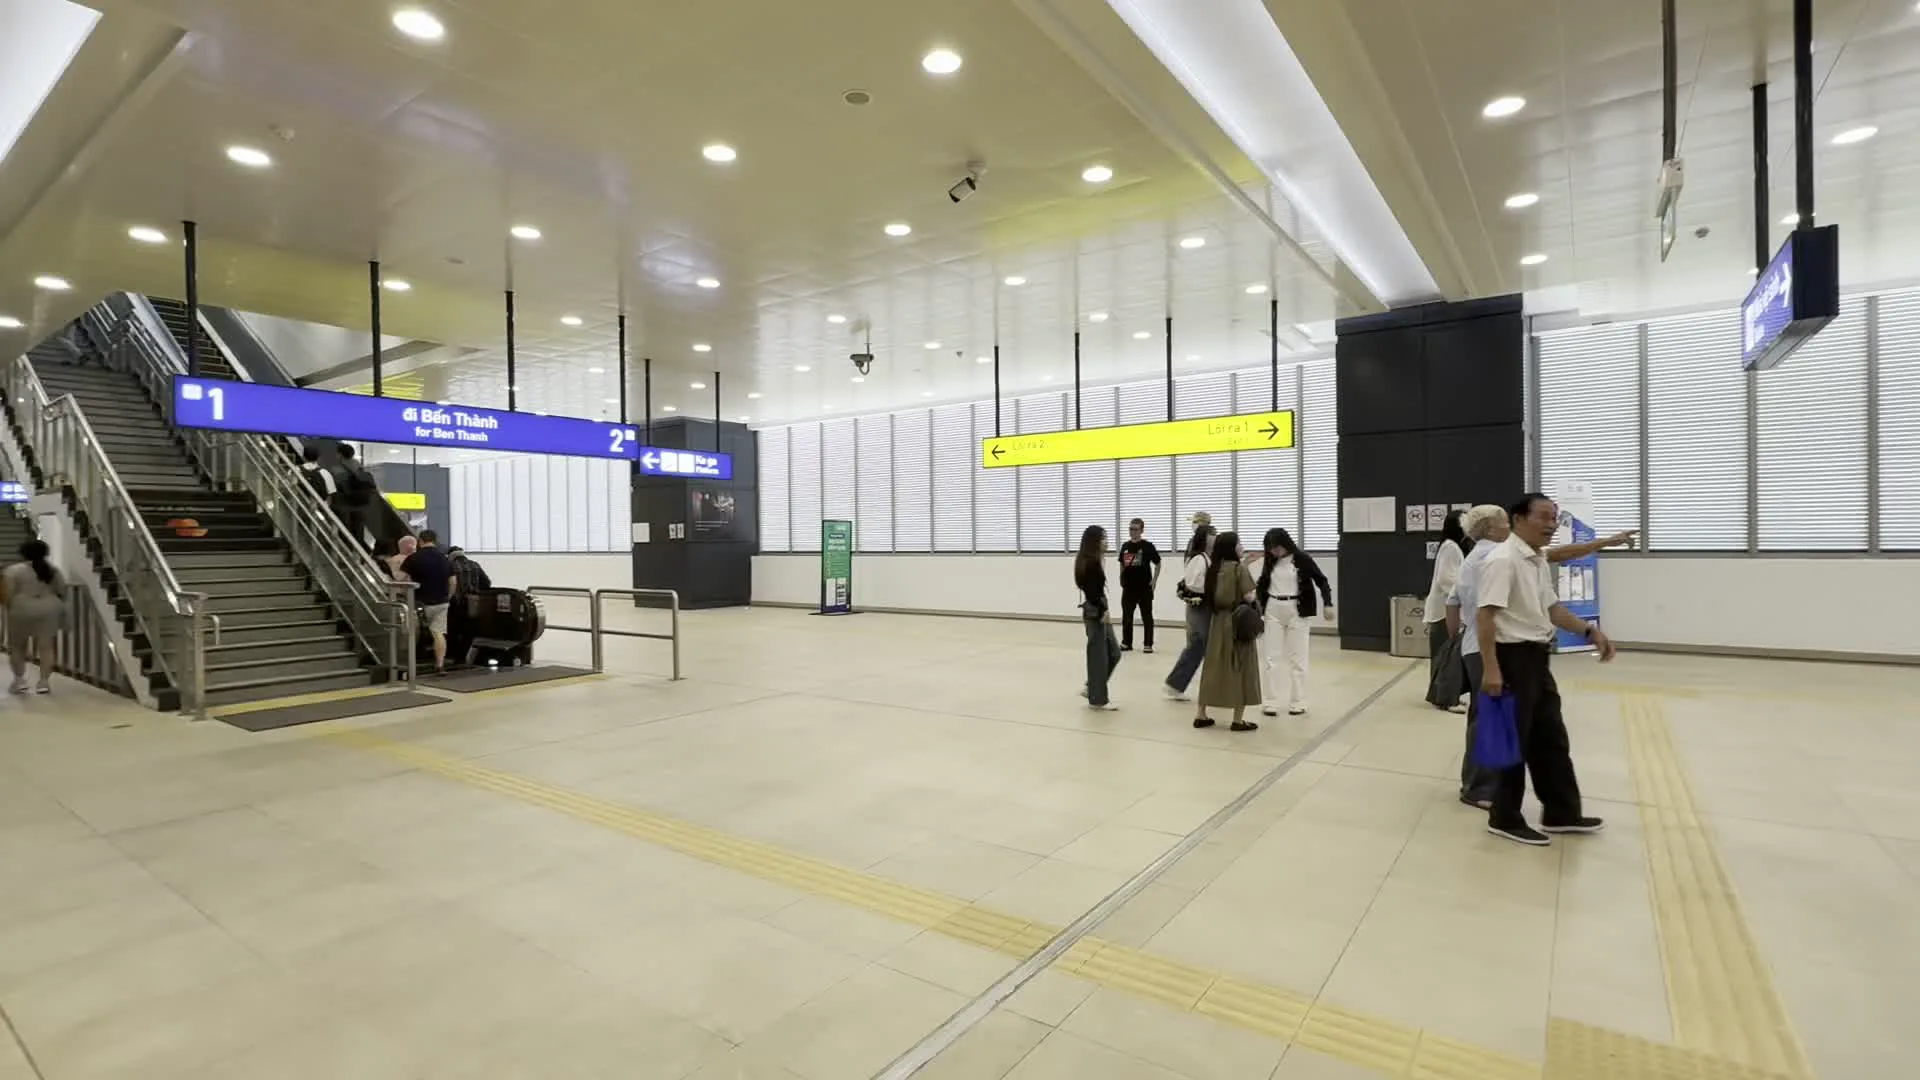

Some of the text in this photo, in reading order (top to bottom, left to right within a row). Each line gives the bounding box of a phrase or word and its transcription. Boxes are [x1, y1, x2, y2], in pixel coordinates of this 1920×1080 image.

[208, 387, 224, 420] 1
[415, 426, 489, 441] for Ben Thanh
[1228, 424, 1241, 433] ra
[609, 429, 624, 452] 2
[1039, 439, 1046, 449] 2
